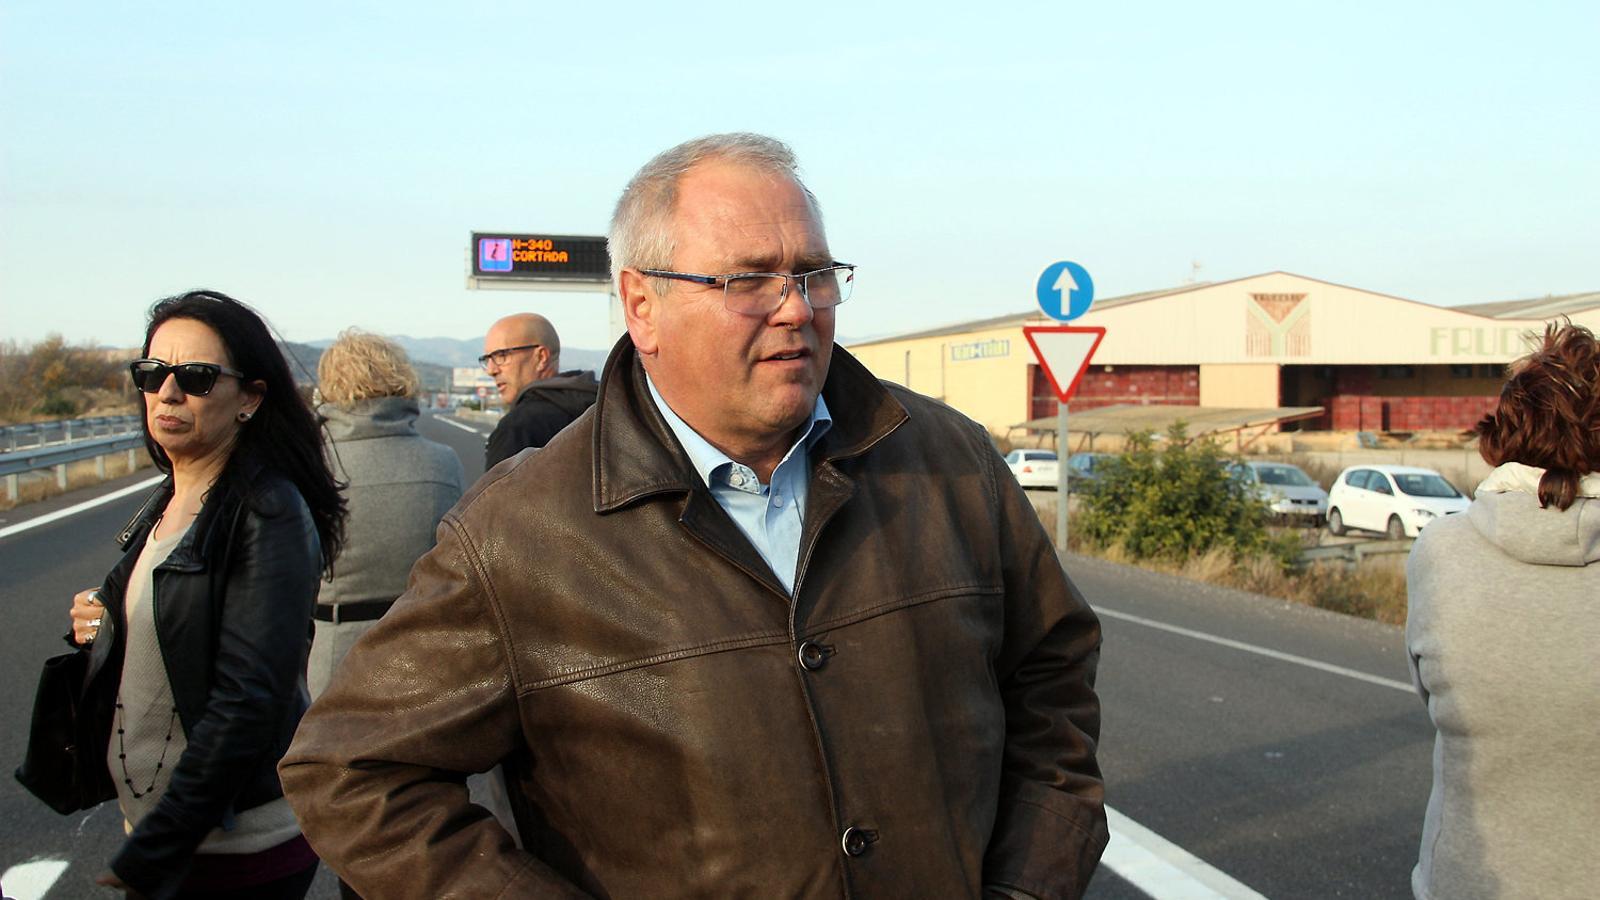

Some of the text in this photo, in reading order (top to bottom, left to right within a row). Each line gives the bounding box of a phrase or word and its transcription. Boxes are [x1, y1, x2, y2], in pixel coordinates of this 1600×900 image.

[513, 239, 552, 250] N-340
[513, 250, 568, 262] CORTADA
[1431, 327, 1530, 356] FRUD
